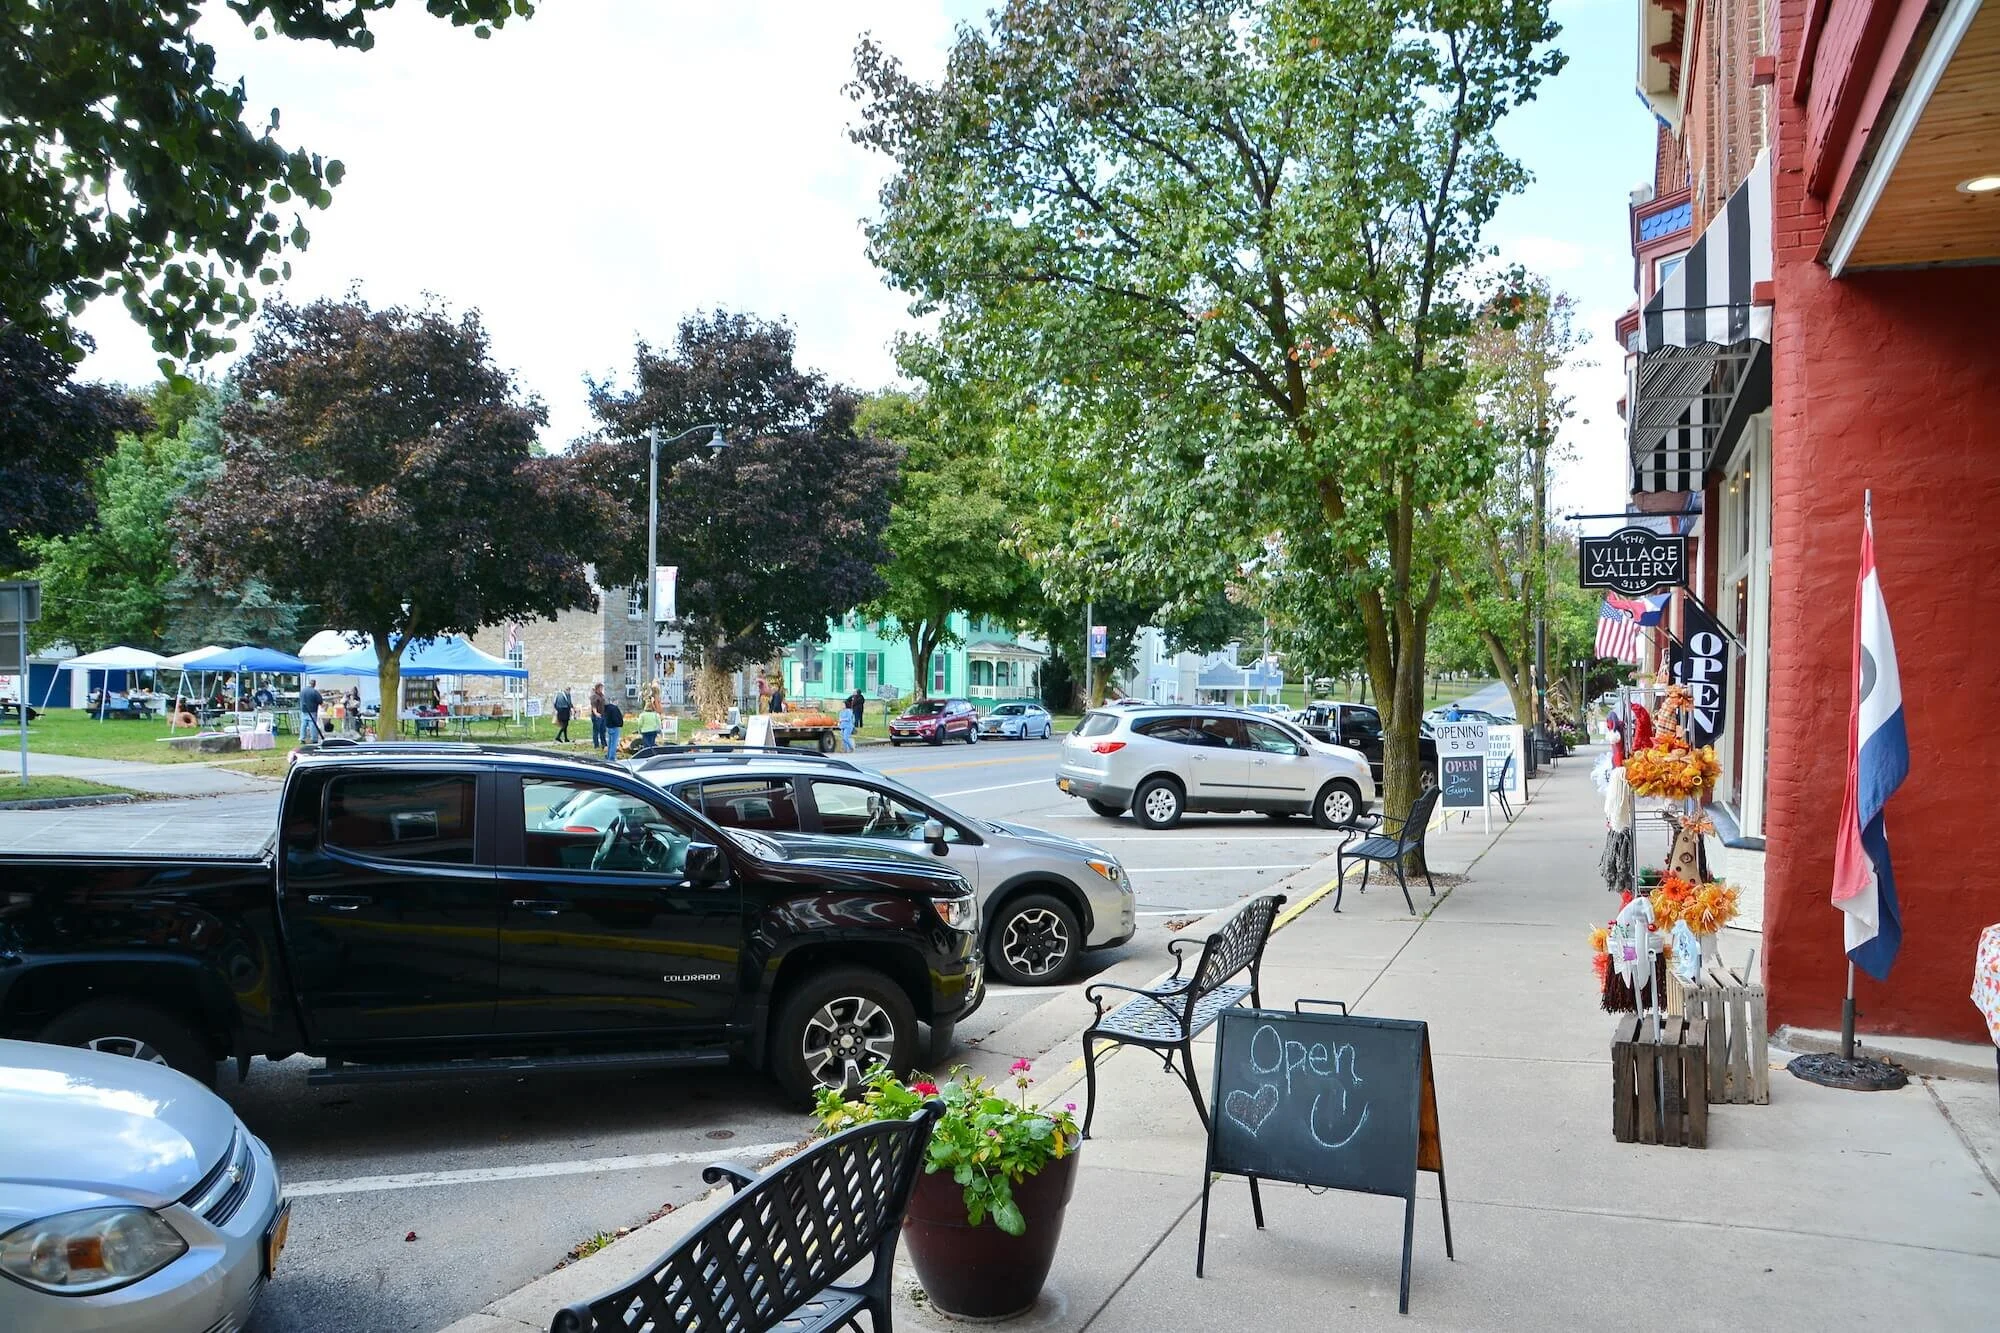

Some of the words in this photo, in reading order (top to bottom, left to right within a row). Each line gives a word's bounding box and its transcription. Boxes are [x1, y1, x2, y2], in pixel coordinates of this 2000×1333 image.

[1621, 534, 1645, 544] THE
[1591, 546, 1678, 562] VILLAGE
[1591, 561, 1678, 577] GALLERY
[1687, 631, 1723, 734] OPEN
[1437, 725, 1484, 739] OPENING
[1451, 741, 1459, 750] 5
[1466, 740, 1475, 749] 8
[1445, 760, 1477, 773] OPEN
[664, 974, 721, 982] COLORADO
[1250, 1024, 1363, 1095] Open
